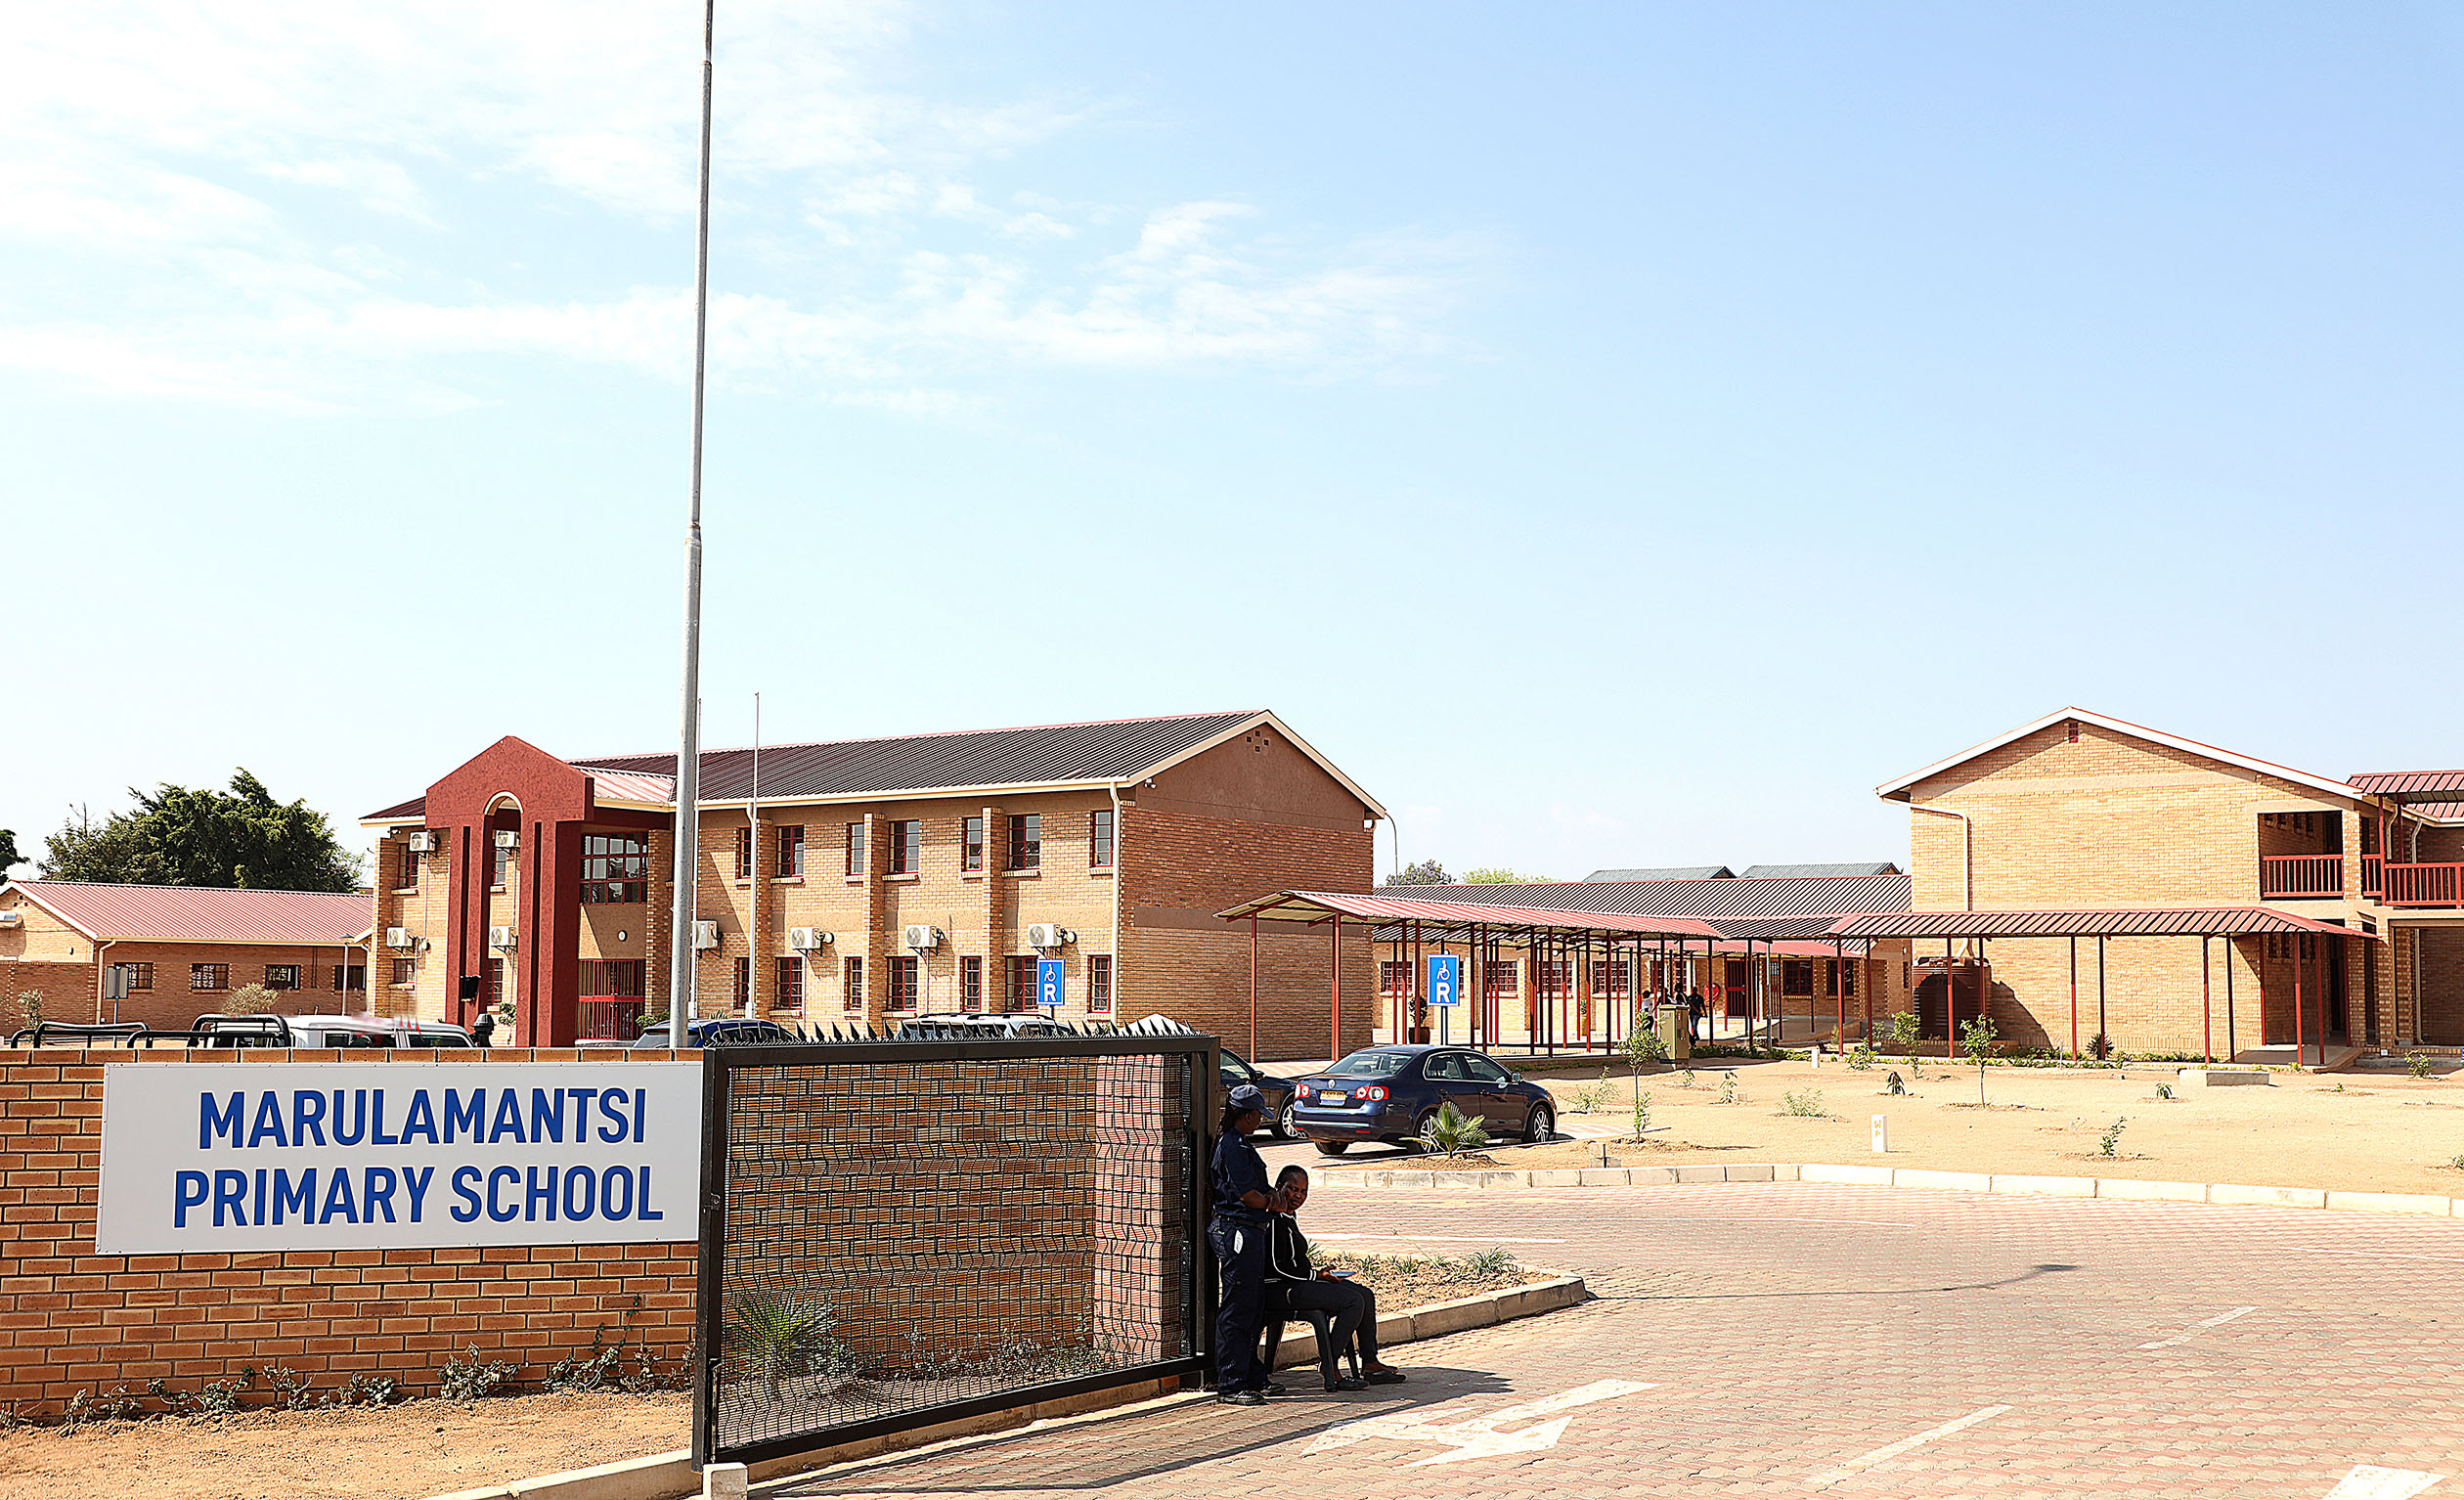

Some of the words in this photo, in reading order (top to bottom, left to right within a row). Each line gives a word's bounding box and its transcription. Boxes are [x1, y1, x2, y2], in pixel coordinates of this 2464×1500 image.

[1043, 983, 1057, 1002] R
[1436, 982, 1451, 1003] R
[199, 1087, 646, 1150] MARULAMANTSI
[174, 1167, 435, 1228] PRIMARY
[450, 1166, 664, 1223] SCHOOL
